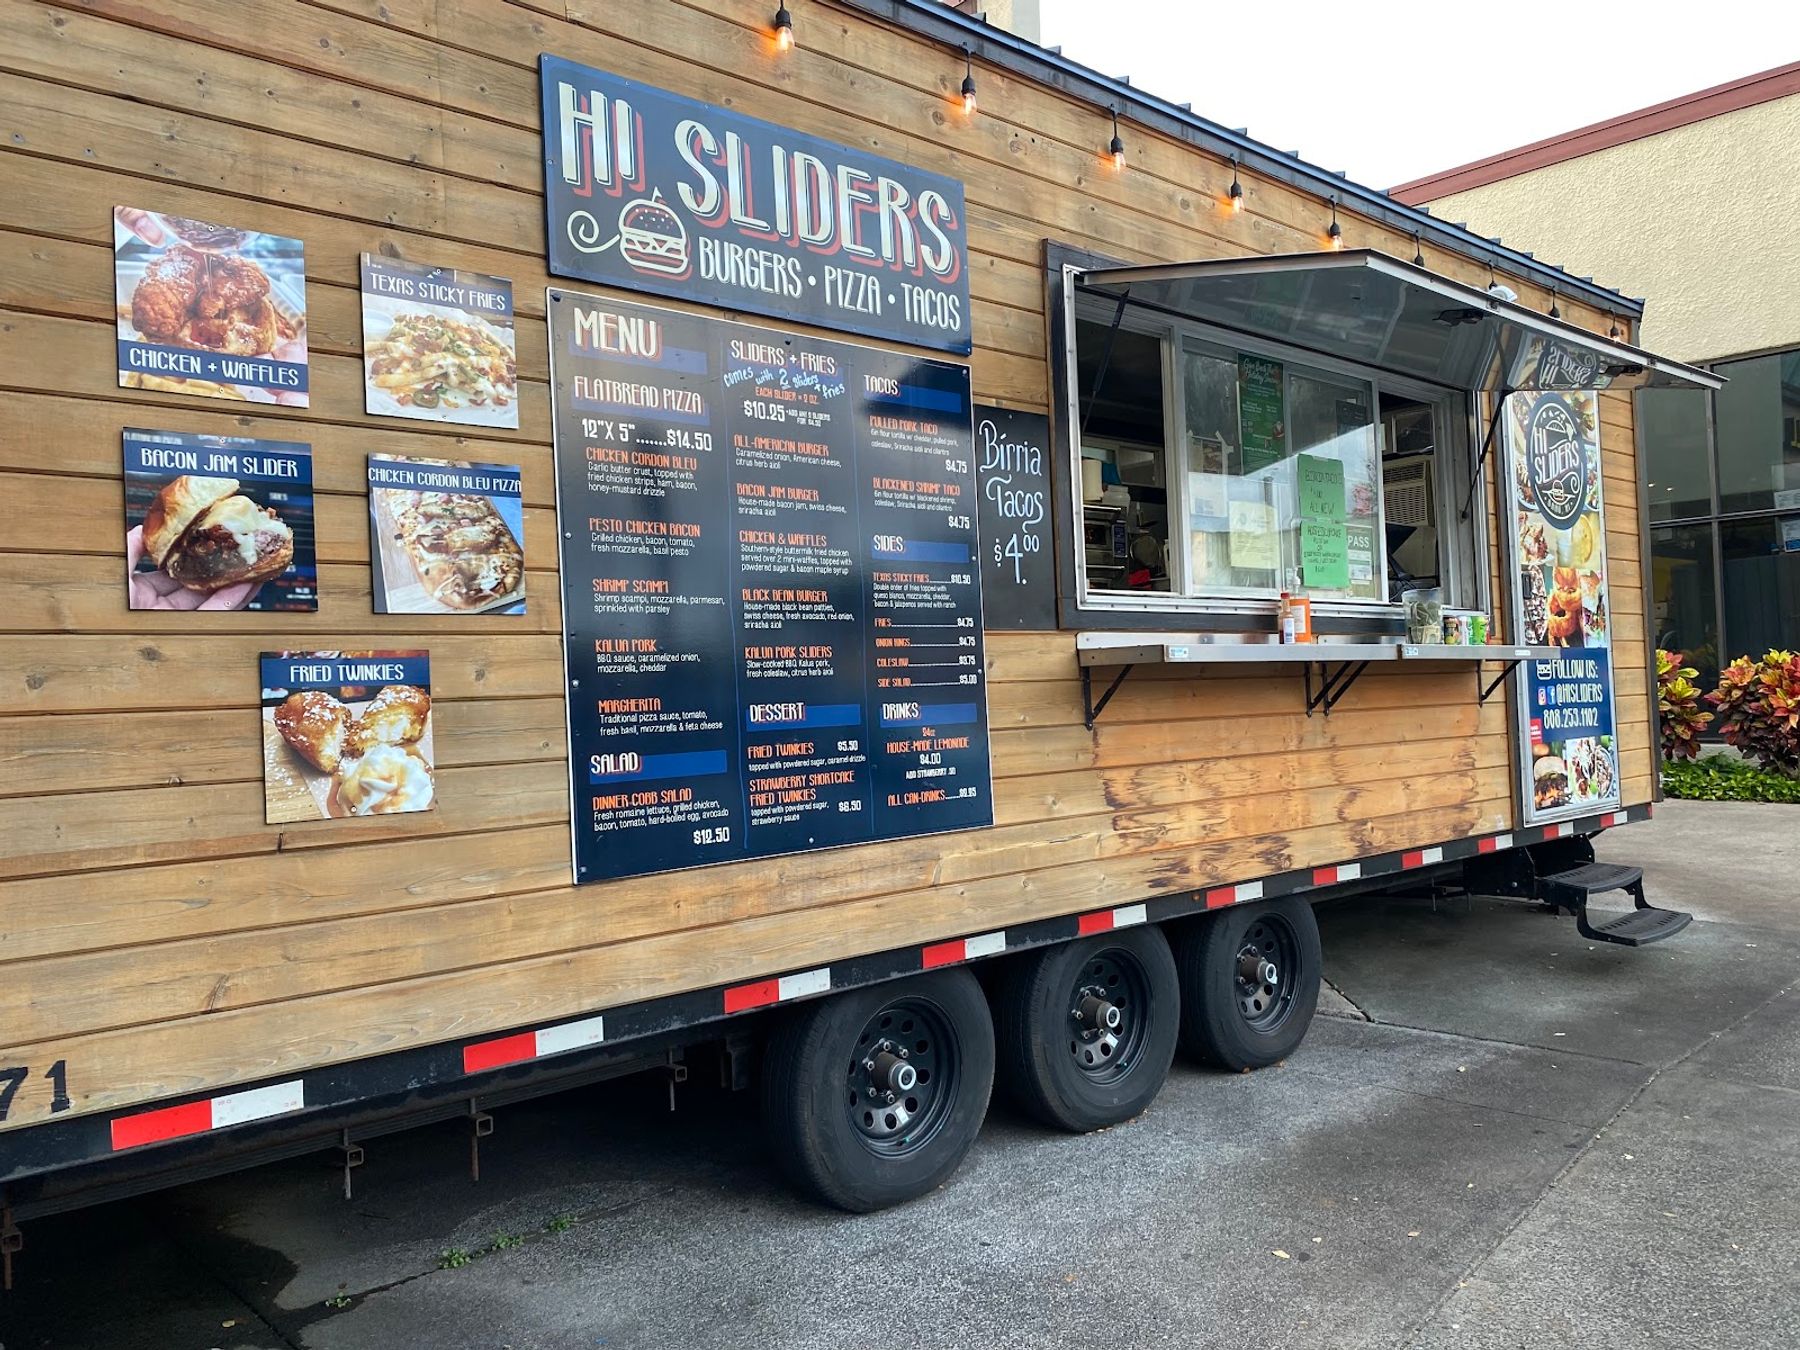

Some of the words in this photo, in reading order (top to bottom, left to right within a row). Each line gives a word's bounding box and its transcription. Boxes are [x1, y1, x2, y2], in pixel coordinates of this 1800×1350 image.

[558, 82, 636, 186] HI
[674, 119, 953, 274] SLIDERS
[370, 272, 414, 295] TEXAS
[419, 282, 464, 306] STICKY
[469, 290, 505, 311] FRIES
[698, 236, 802, 298] BURGERS
[825, 266, 881, 316] PIZZA
[901, 283, 960, 331] TACOS
[574, 307, 656, 357] MENU
[130, 348, 201, 373] CHICKEN
[208, 362, 217, 372] +
[222, 360, 299, 386] WAFFLES
[731, 340, 784, 366] SLIDERS
[800, 352, 835, 375] FRIES
[724, 367, 753, 387] comes
[755, 369, 774, 385] with
[793, 372, 819, 388] sliders
[822, 383, 845, 399] fries
[864, 375, 898, 395] TACOS
[574, 376, 659, 408] FLATBREAD
[663, 389, 701, 414] PIZZA
[755, 387, 773, 398] EACH
[775, 389, 796, 401] SLIDER
[743, 399, 785, 422] $10.25
[920, 422, 938, 435] TACO
[734, 434, 796, 453] ALL-AMERICAN
[798, 441, 829, 456] BURGER
[979, 420, 1042, 477] Birria
[1534, 427, 1547, 454] HI
[141, 448, 197, 470] BACON
[203, 454, 238, 473] JAM
[243, 457, 298, 477] SLIDER
[586, 447, 628, 464] CHICKEN
[632, 452, 670, 467] CORDON
[673, 455, 697, 471] BLEU
[736, 448, 772, 459] Caramelized
[793, 454, 819, 465] American
[946, 459, 967, 473] $4.75
[1534, 440, 1579, 485] SLIDERS
[368, 467, 414, 484] CHICKEN
[417, 472, 459, 488] CORDON
[463, 476, 490, 491] BLEU
[493, 478, 521, 493] PIZZA
[588, 462, 609, 472] Garlic
[610, 464, 631, 474] butter
[634, 467, 652, 476] crust,
[654, 468, 678, 480] topped
[679, 471, 694, 480] with
[588, 473, 604, 482] fried
[606, 474, 633, 484] chicken
[635, 476, 656, 488] strips,
[657, 478, 673, 489] ham,
[675, 481, 697, 491] bacon,
[588, 482, 641, 495] honey-mustard
[643, 486, 665, 497] drizzle
[736, 482, 765, 497] BACON
[768, 486, 785, 499] JAM
[787, 487, 819, 501] BURGER
[985, 475, 1044, 534] Tacos
[589, 517, 623, 532] PESTO
[626, 519, 667, 535] CHICKEN
[670, 523, 700, 537] BACON
[948, 516, 970, 529] $4.75
[591, 532, 614, 542] Grilled
[615, 534, 644, 545] chicken,
[646, 536, 668, 546] bacon,
[670, 538, 695, 548] tomato,
[739, 530, 775, 544] CHICKEN
[778, 533, 785, 545] &
[788, 533, 827, 547] WAFFLES
[873, 535, 903, 552] SIDES
[1348, 535, 1370, 548] PASS
[591, 542, 610, 553] fresh
[612, 544, 652, 555] mozzarella,
[654, 546, 669, 555] basil
[671, 548, 689, 557] pesto
[592, 578, 629, 592] SHRIMP
[632, 580, 669, 593] SCAMPI
[742, 588, 769, 601] BLACK
[772, 589, 794, 602] BEAN
[796, 590, 828, 602] BURGER
[594, 593, 620, 604] Shrimp
[621, 595, 648, 604] scampi,
[650, 595, 689, 605] mozzarella,
[690, 597, 725, 606] parmesan,
[594, 603, 627, 613] sprinkled
[628, 604, 644, 613] with
[645, 605, 670, 615] parsley
[595, 639, 628, 652] KALUA
[631, 639, 657, 652] PORK
[744, 646, 773, 659] KALUA
[775, 646, 796, 659] PORK
[799, 646, 832, 658] SLIDERS
[597, 654, 612, 663] BBQ
[613, 654, 636, 663] sauce,
[638, 653, 679, 662] caramelized
[681, 653, 700, 662] onion,
[290, 665, 331, 683] FRIED
[337, 664, 404, 681] TWINKIES
[597, 664, 638, 673] mozzarella,
[639, 663, 667, 672] cheddar
[1552, 659, 1584, 679] FOLLOW
[1586, 659, 1599, 678] US:
[1556, 683, 1603, 706] @HISLIDERS
[598, 698, 661, 713] MARGHERITA
[750, 702, 804, 722] DESSERT
[882, 702, 919, 720] DRINKS
[600, 714, 637, 724] Traditional
[639, 714, 657, 723] pizza
[659, 713, 681, 721] sauce,
[682, 710, 708, 720] tomato,
[1543, 707, 1599, 729] 808.253.1102
[600, 726, 619, 736] fresh
[620, 725, 639, 735] basil,
[641, 723, 677, 733] mozzarella
[685, 722, 698, 731] feta
[700, 721, 723, 730] cheese
[747, 746, 772, 759] FRIED
[775, 742, 814, 757] TWINKIES
[838, 740, 858, 751] $5.50
[887, 740, 932, 754] HOUSE-MADE
[934, 737, 969, 751] LEMONADE
[590, 752, 638, 774] SALAD
[920, 753, 941, 765] $4.00
[750, 775, 806, 792] STRAWBERRY
[809, 770, 855, 785] SHORTCAKE
[593, 794, 629, 811] DINNER
[631, 791, 658, 807] COBB
[661, 788, 692, 803] SALAD
[750, 793, 774, 807] FRIED
[778, 788, 816, 804] TWINKIES
[888, 794, 902, 806] ALL
[594, 810, 614, 821] Fresh
[616, 809, 645, 818] romaine
[647, 805, 672, 815] lettuce,
[673, 802, 692, 815] grilled
[694, 800, 720, 810] chicken,
[594, 822, 618, 832] bacon,
[619, 818, 647, 828] tomato,
[648, 813, 686, 825] hard-boiled
[687, 812, 700, 822] egg,
[702, 809, 729, 818] avocado
[693, 826, 730, 845] $12.50
